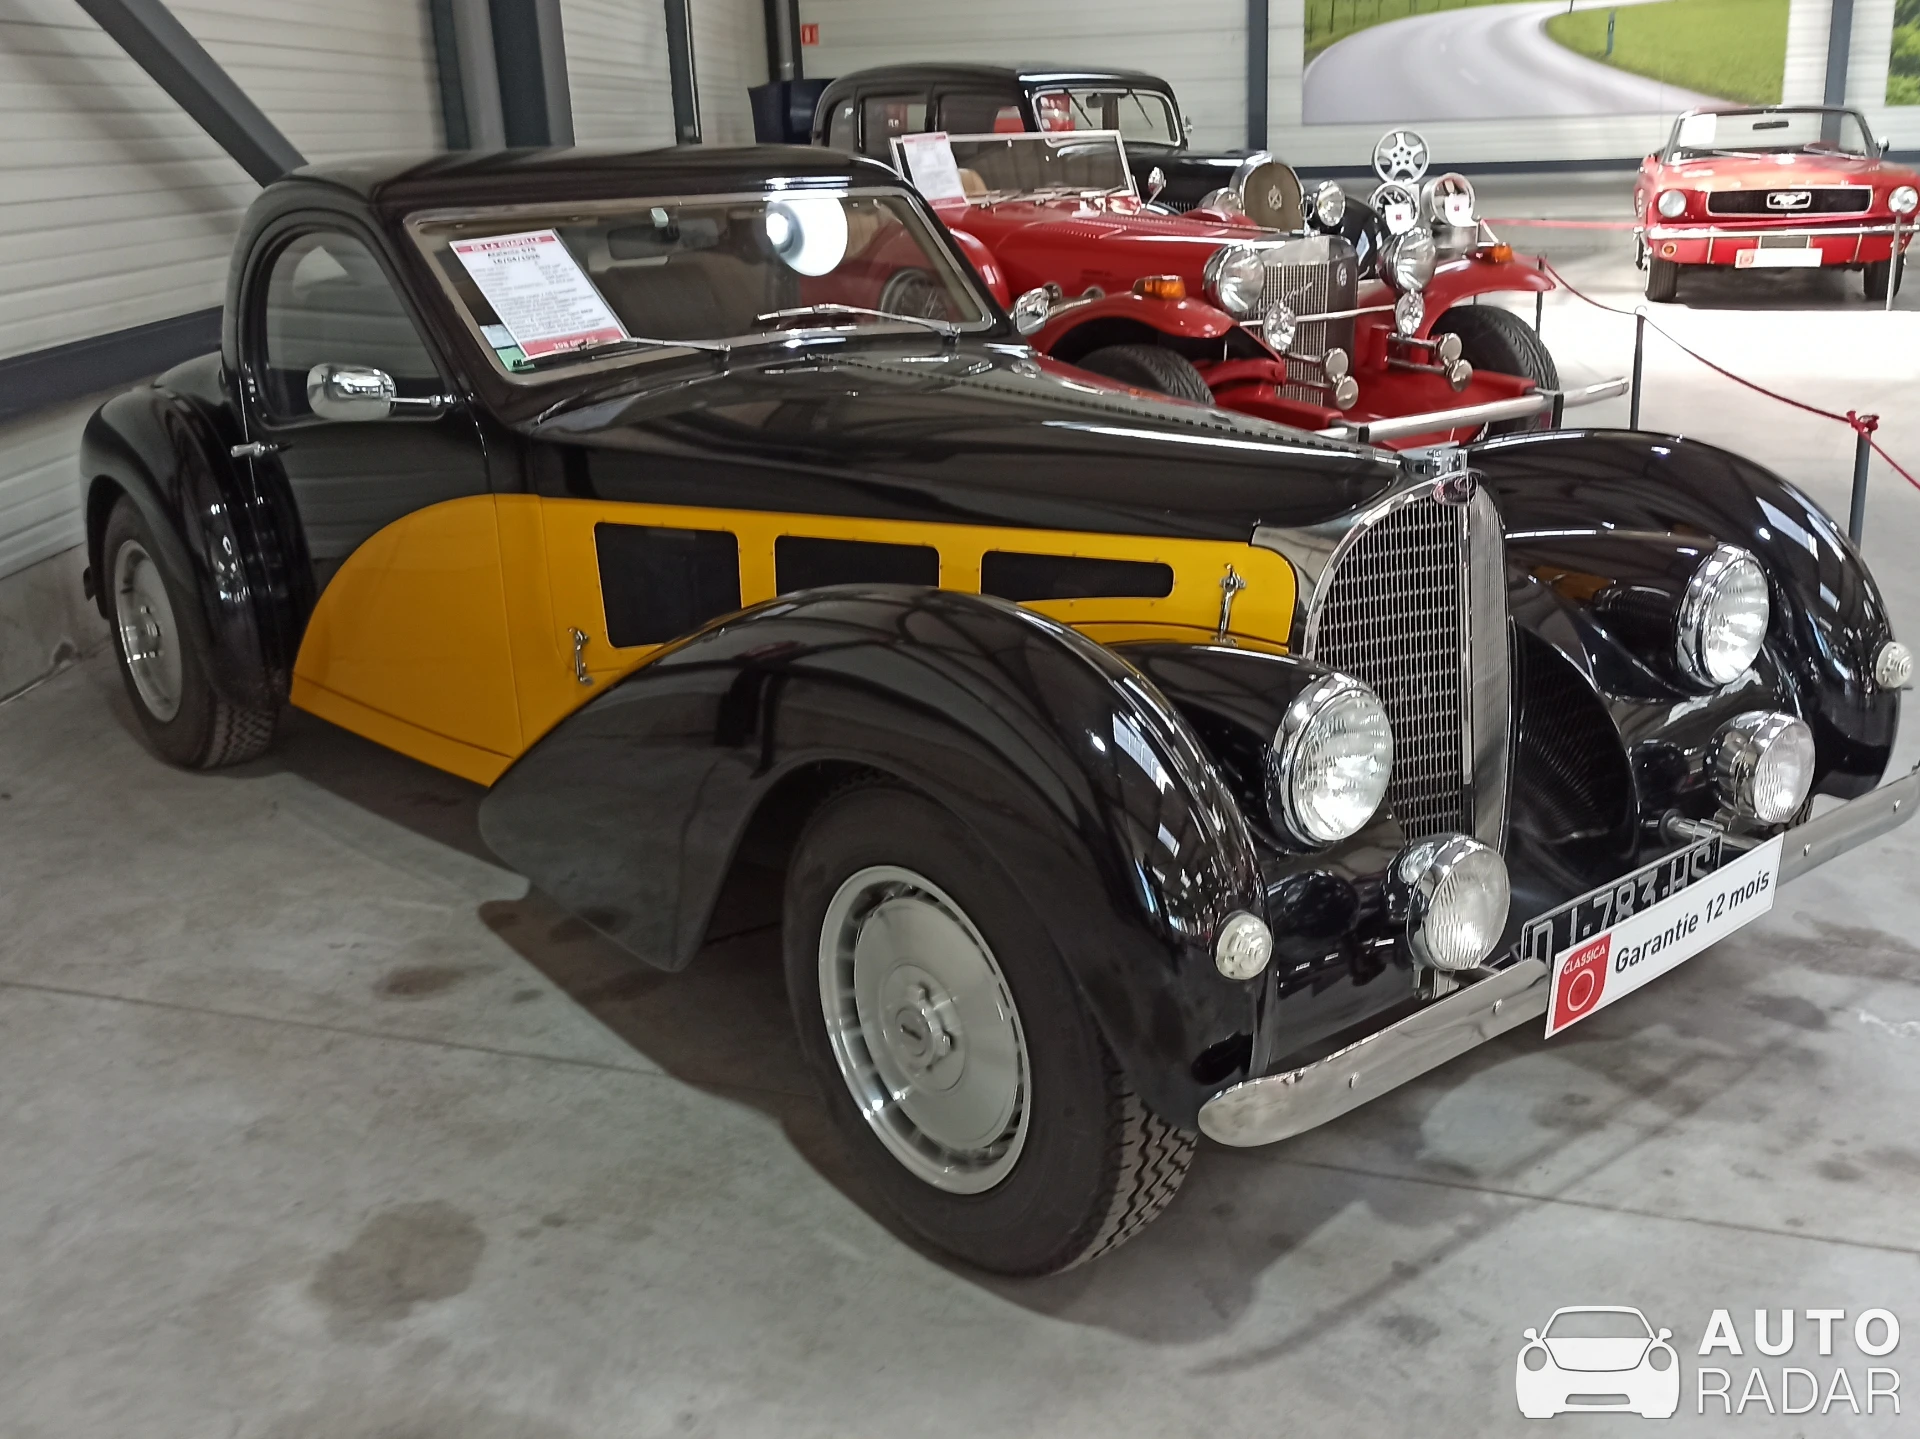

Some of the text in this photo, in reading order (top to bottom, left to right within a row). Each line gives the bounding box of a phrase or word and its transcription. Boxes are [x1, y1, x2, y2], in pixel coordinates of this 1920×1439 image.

[1615, 870, 1770, 974] Garantie 12 mois
[1563, 943, 1606, 975] CLASSICA
